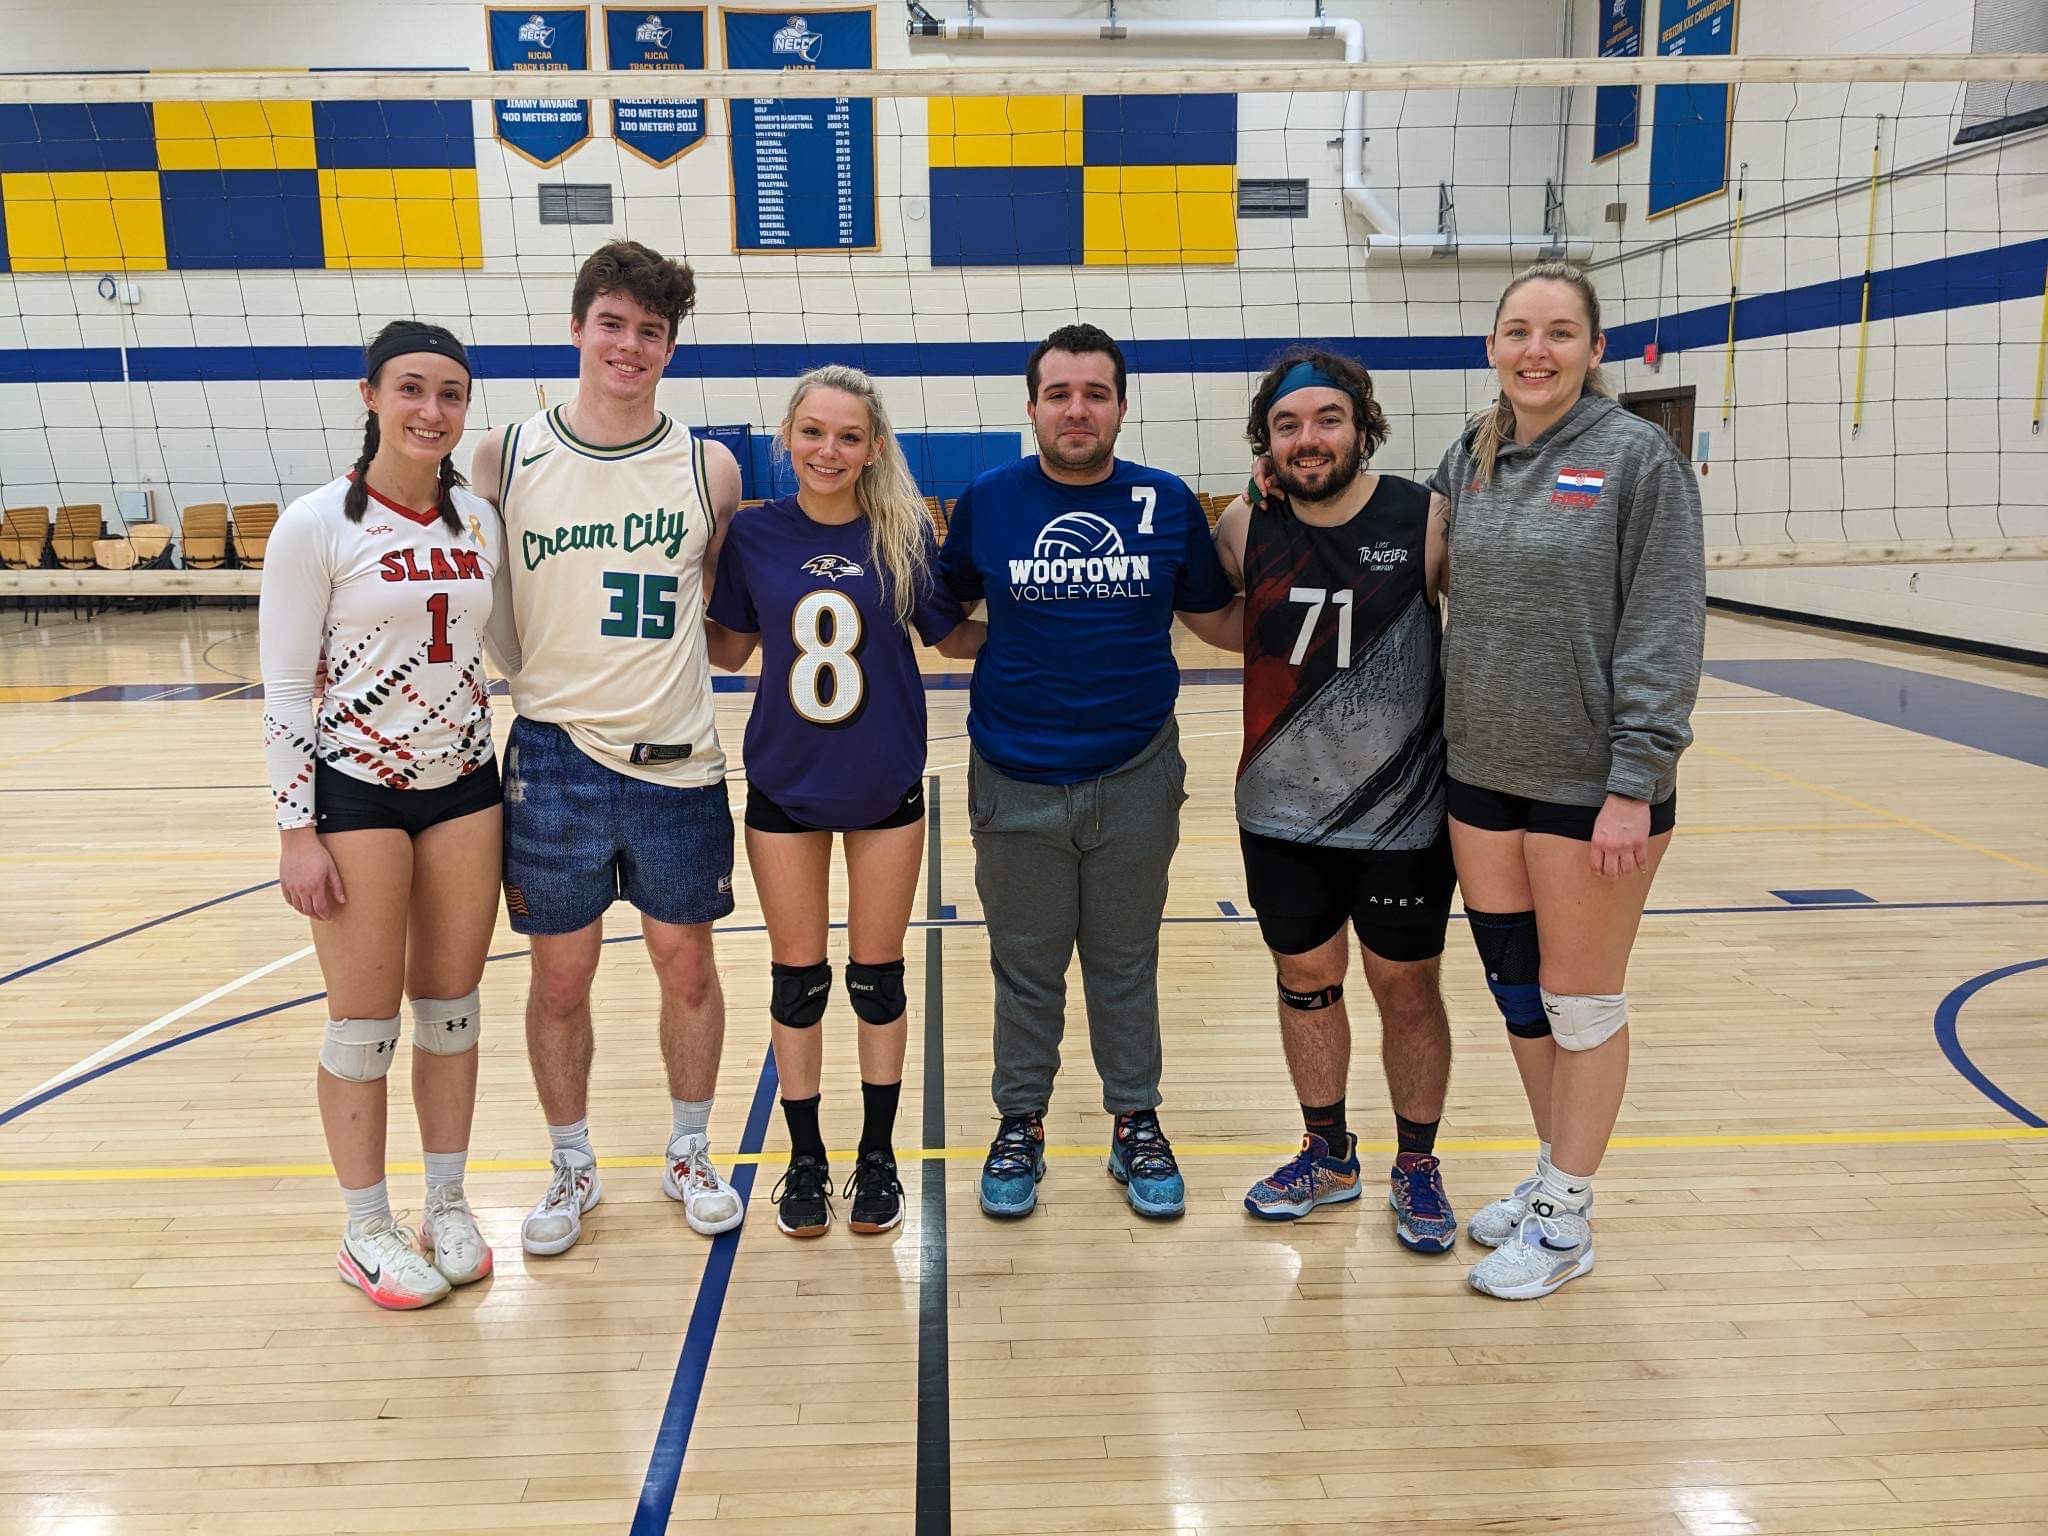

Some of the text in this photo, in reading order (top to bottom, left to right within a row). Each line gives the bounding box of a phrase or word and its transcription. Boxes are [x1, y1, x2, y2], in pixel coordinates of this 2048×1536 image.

[520, 31, 547, 40] NECC
[638, 31, 664, 40] NECC
[775, 38, 810, 51] NECC
[528, 52, 552, 60] NJCAA
[645, 52, 669, 60] NJCAA
[506, 99, 578, 108] JIMMY MWANGI
[502, 113, 582, 122] 400 METERS 2006
[619, 108, 698, 118] 200 METERS 2010
[621, 122, 698, 132] 100 METERS 2011
[1131, 487, 1157, 534] 7
[522, 507, 689, 571] Cream City
[1358, 546, 1408, 565] TRAVELER
[380, 548, 485, 582] SLAM
[1009, 555, 1150, 585] WOOTOWN
[1009, 583, 1151, 601] VOLLEYBALL
[600, 571, 679, 640] 35
[426, 592, 454, 664] 1
[1288, 587, 1353, 668] 71
[788, 589, 864, 724] 8
[1369, 896, 1425, 907] APEX
